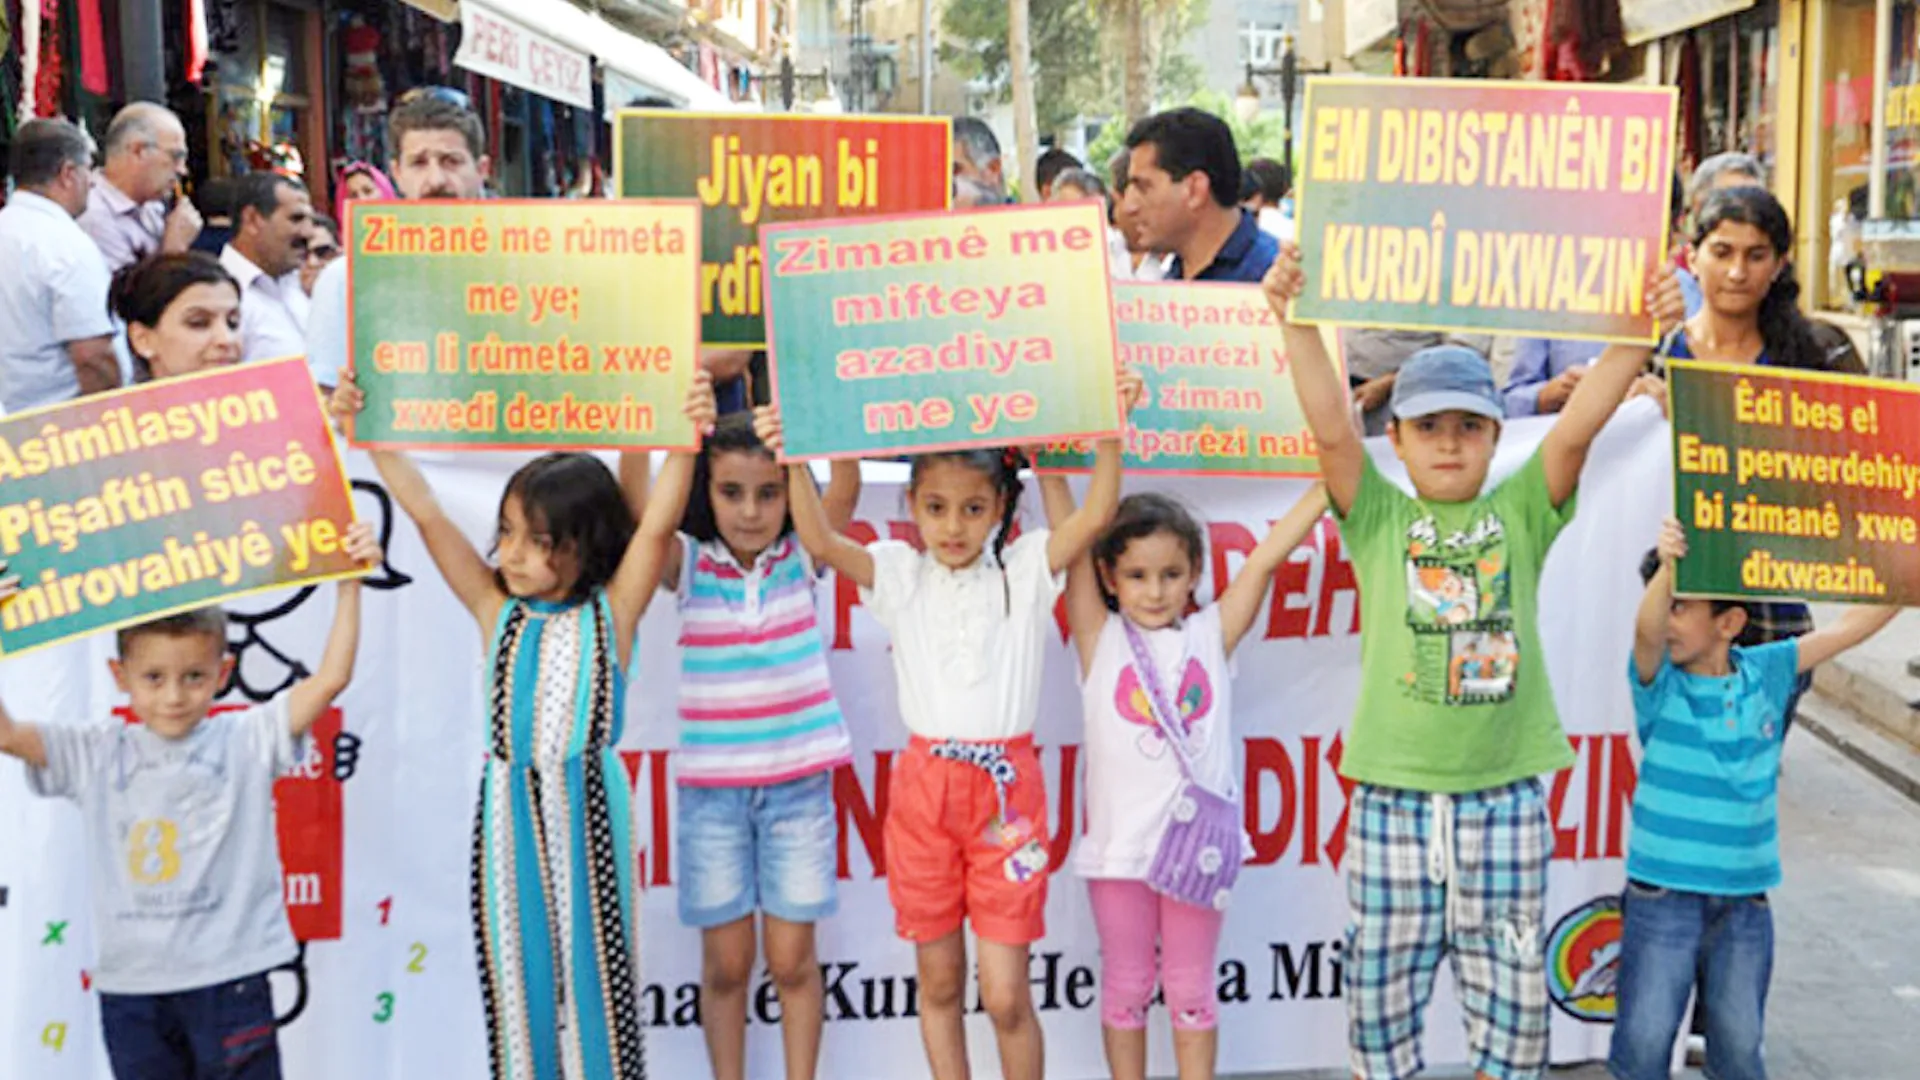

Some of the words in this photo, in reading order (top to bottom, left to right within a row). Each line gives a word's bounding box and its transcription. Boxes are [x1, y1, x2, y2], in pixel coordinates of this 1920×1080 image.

[1311, 108, 1370, 182] EM
[1377, 96, 1612, 191] DIBISTANÊN
[1620, 117, 1663, 194] BI
[697, 135, 822, 224] Jiyan
[837, 138, 878, 207] bi
[362, 216, 489, 254] Zimanê
[501, 226, 550, 254] me
[565, 219, 685, 254] rûmeta
[776, 226, 988, 276] Zimanê
[1009, 224, 1093, 254] me
[701, 245, 761, 315] rdî
[1321, 209, 1447, 305] KURDÎ
[1451, 230, 1646, 315] DIXWAZIN
[467, 284, 519, 314] me
[529, 284, 579, 323] ye;
[833, 281, 1046, 326] mifteya
[1117, 297, 1279, 330] elatparêz
[373, 342, 428, 373] em
[437, 332, 458, 372] li
[468, 332, 590, 372] rûmeta
[602, 344, 671, 372] xwe
[836, 333, 1053, 380] azadiya
[1272, 350, 1290, 374] y
[505, 392, 653, 432] derkevin
[863, 397, 953, 433] me
[970, 390, 1037, 433] ye
[1160, 380, 1263, 411] ziman
[1791, 391, 1844, 431] bes
[1851, 400, 1878, 435] e!
[0, 388, 279, 481] Asîmîlasyon
[1259, 430, 1319, 457] nab
[1679, 434, 1729, 475] Em
[1, 472, 192, 554] Pişaftin
[202, 441, 316, 502] sûcê
[1694, 490, 1724, 530] bi
[1731, 494, 1840, 539] zimanê
[1857, 512, 1916, 544] xwe
[2, 520, 273, 631] mirovahiyê
[1742, 549, 1886, 595] dixwazin.
[128, 817, 182, 886] 8
[376, 896, 393, 926] 1
[406, 943, 429, 974] 2
[372, 992, 396, 1022] 3
